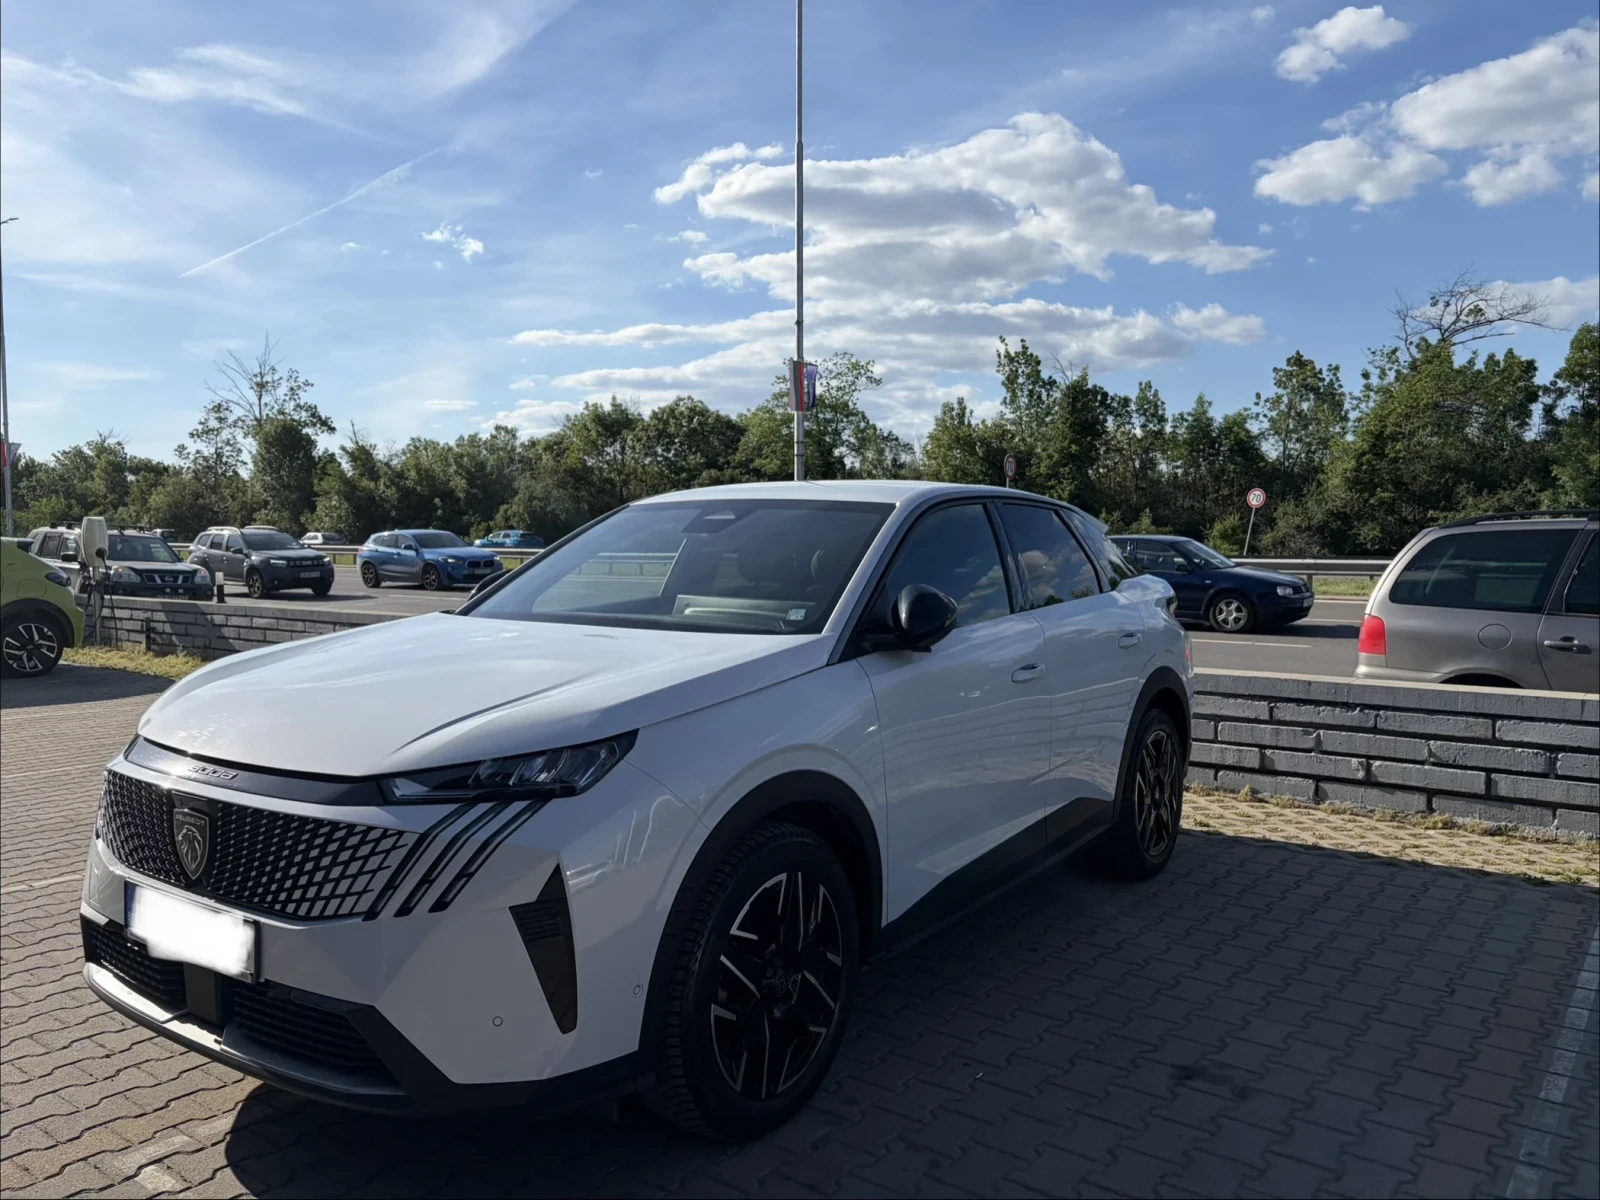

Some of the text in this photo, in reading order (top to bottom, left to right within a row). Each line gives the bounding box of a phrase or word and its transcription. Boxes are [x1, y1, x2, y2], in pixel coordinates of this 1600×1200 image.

[1251, 493, 1262, 503] 70
[188, 764, 238, 780] 3008
[175, 814, 205, 826] PEUGEOT
